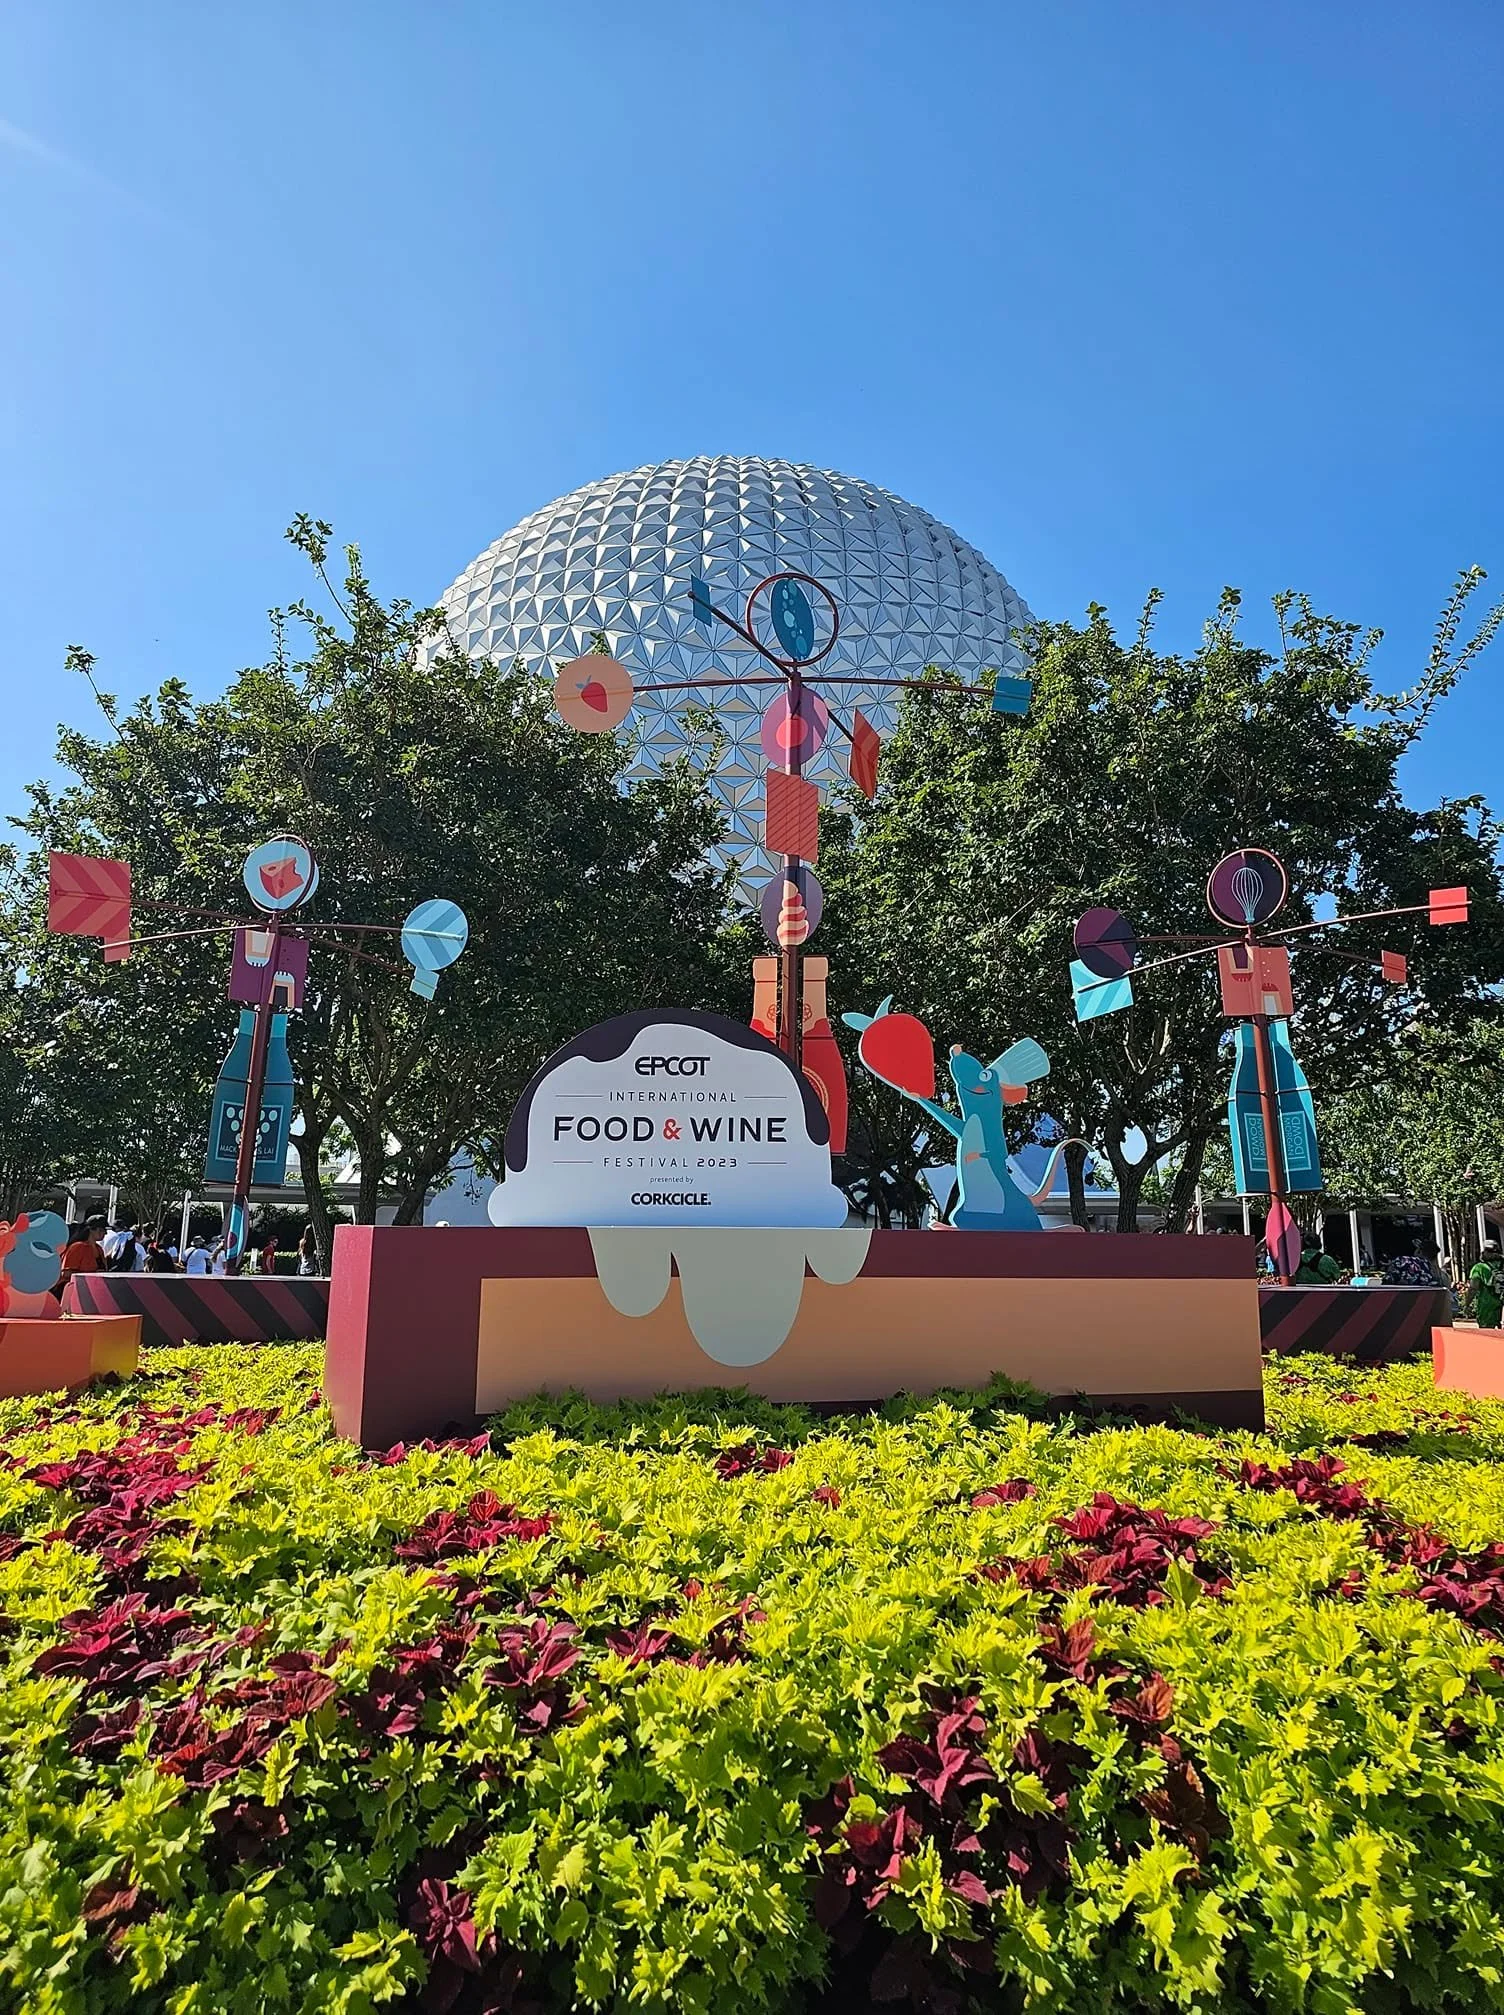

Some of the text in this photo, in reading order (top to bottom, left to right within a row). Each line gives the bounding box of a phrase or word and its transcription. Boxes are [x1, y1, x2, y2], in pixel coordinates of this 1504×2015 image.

[634, 1056, 711, 1076] EPCOT
[609, 1091, 737, 1103] INTERNATIONAL
[553, 1116, 787, 1142] FOOD & WINE
[603, 1157, 737, 1168] FESTIVAL 2023
[649, 1176, 694, 1185] presented by
